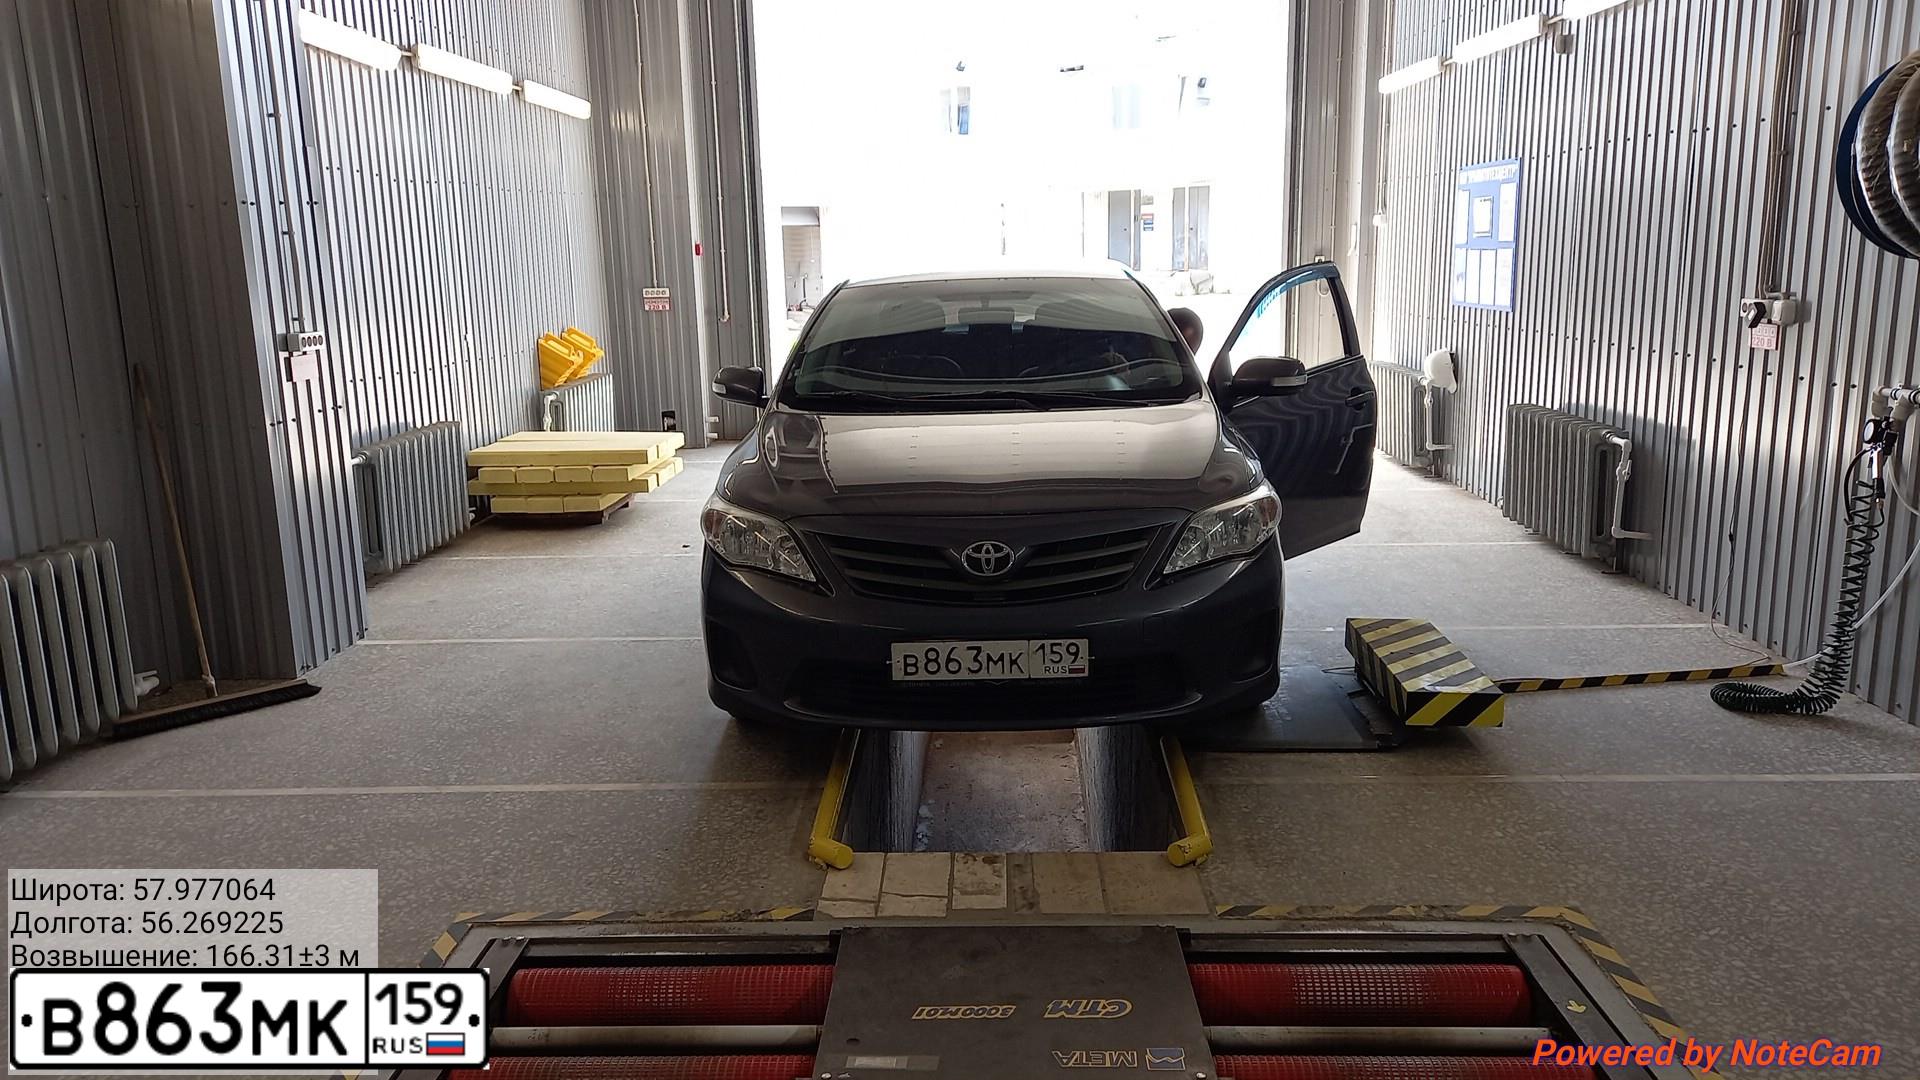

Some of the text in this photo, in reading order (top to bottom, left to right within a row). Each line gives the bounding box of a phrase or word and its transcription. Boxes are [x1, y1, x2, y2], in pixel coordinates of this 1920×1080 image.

[903, 642, 1080, 676] В863МК 159
[1044, 665, 1067, 674] RUS
